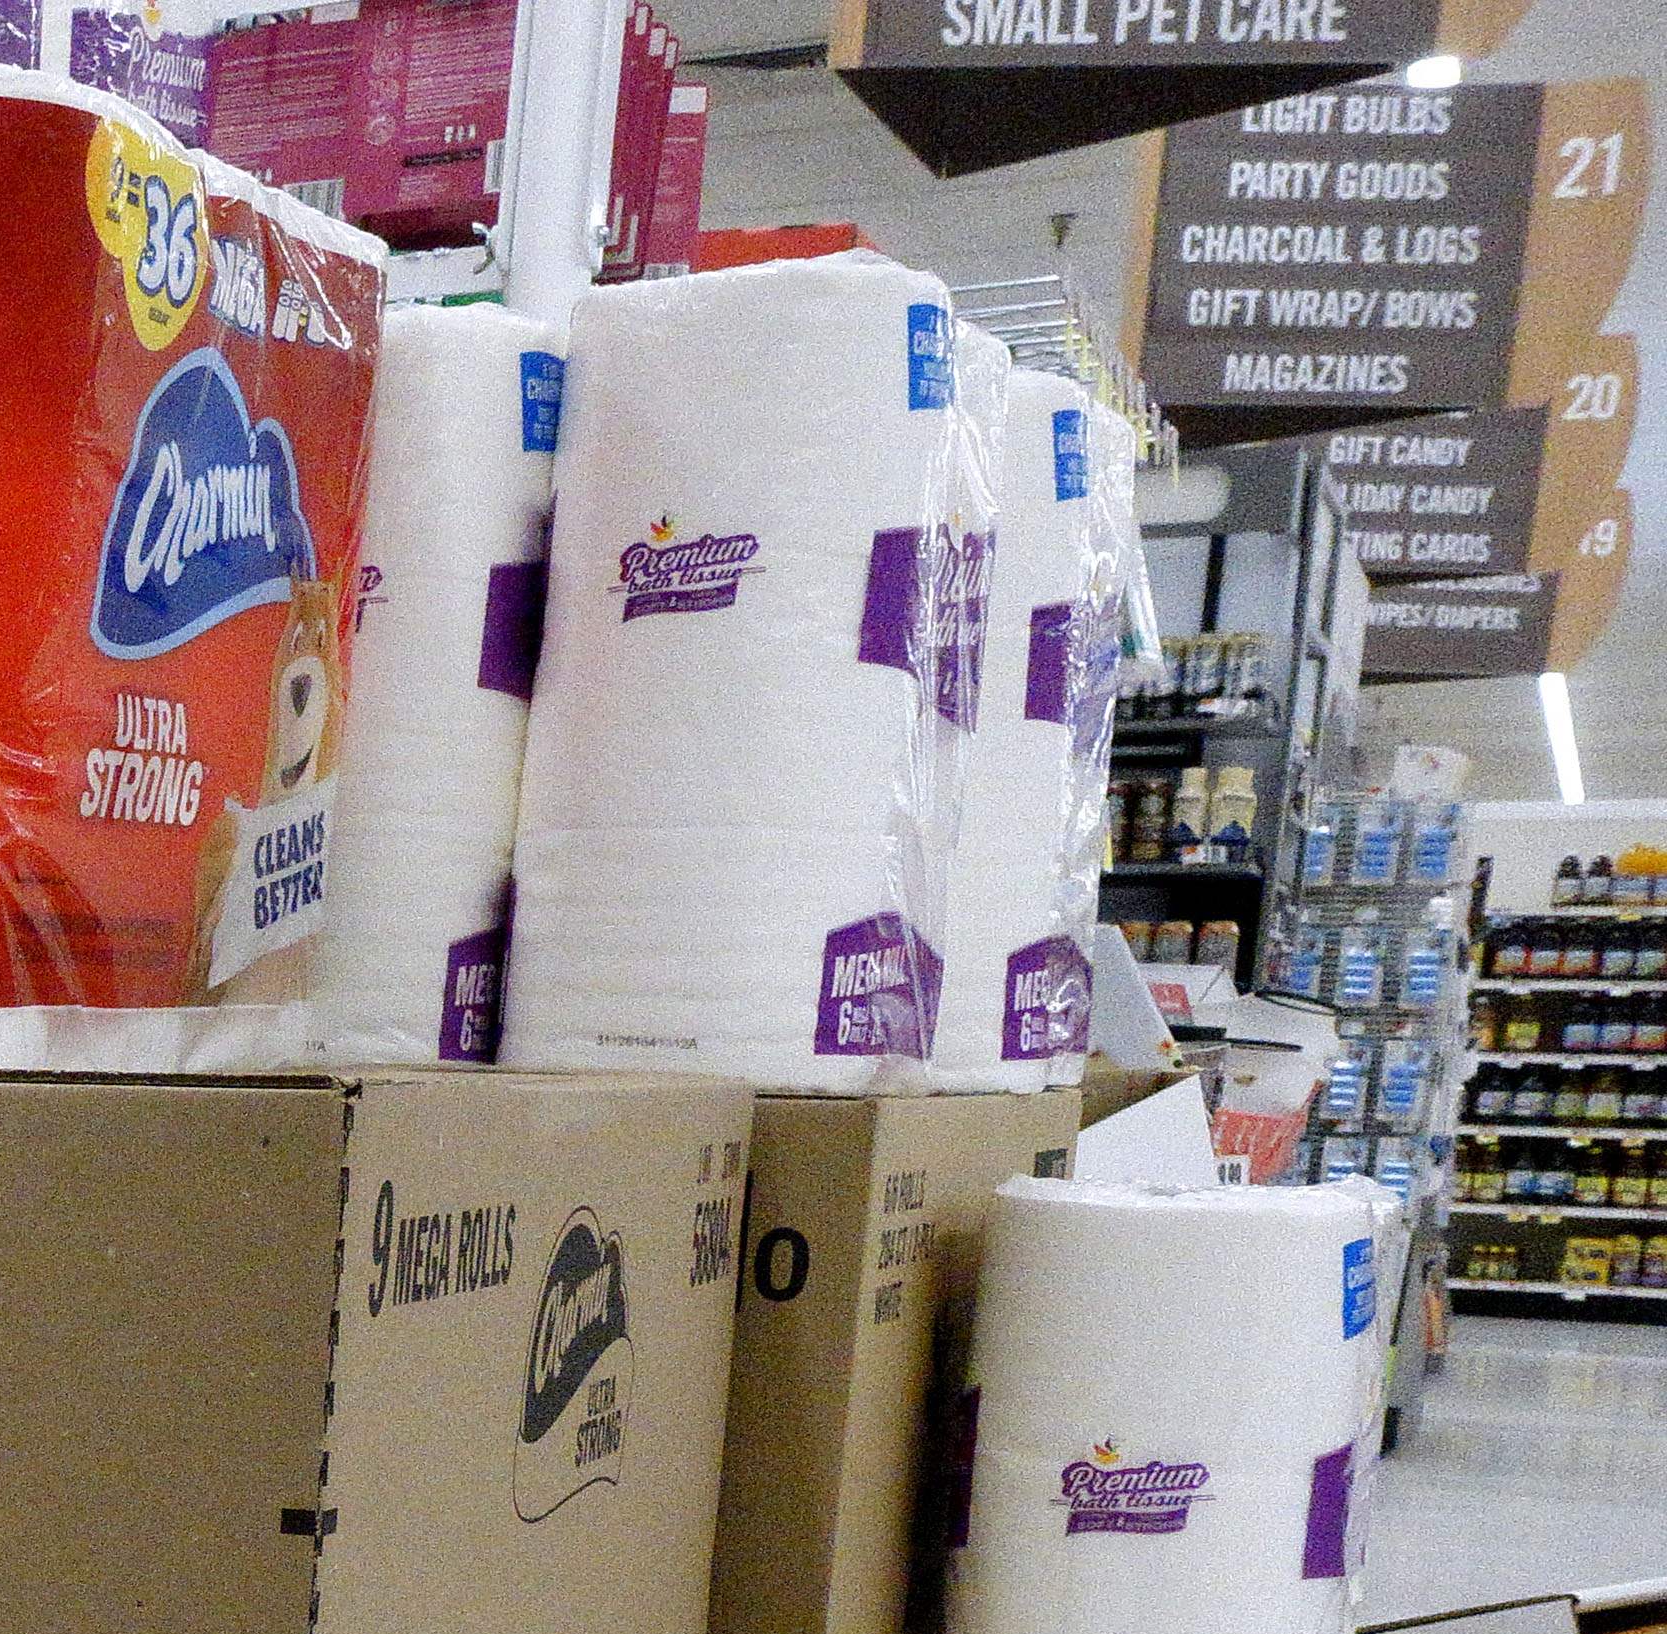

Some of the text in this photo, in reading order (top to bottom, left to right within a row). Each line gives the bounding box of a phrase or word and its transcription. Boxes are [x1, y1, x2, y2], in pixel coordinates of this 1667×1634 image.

[942, 0, 1348, 47] SMALL PET CARE
[128, 28, 206, 93] Premium
[1242, 97, 1452, 135] LIGHT BULBS
[1228, 161, 1451, 202] PARTY GOODS
[1554, 134, 1624, 198] 21
[139, 176, 197, 295] 36
[1181, 225, 1481, 265] CHARCOAL & LOGS
[1188, 288, 1478, 330] GIFT WRAP/ BOWS
[1225, 353, 1409, 394] MAGAZINES
[1563, 374, 1620, 421] 20
[1330, 436, 1472, 466] GIFT CANDY
[123, 430, 278, 596] Charmin
[1410, 486, 1494, 514] CANDY
[627, 538, 756, 578] Premium
[1410, 533, 1491, 562] CARDS
[627, 567, 743, 593] bath tissue
[115, 694, 188, 749] ULTRA
[80, 747, 201, 826] STRONG
[254, 809, 326, 879] CLEANS
[369, 1179, 517, 1318] 9 MEGA ROLLS
[1069, 1467, 1204, 1495] Premium
[1070, 1493, 1193, 1510] bath tissue
